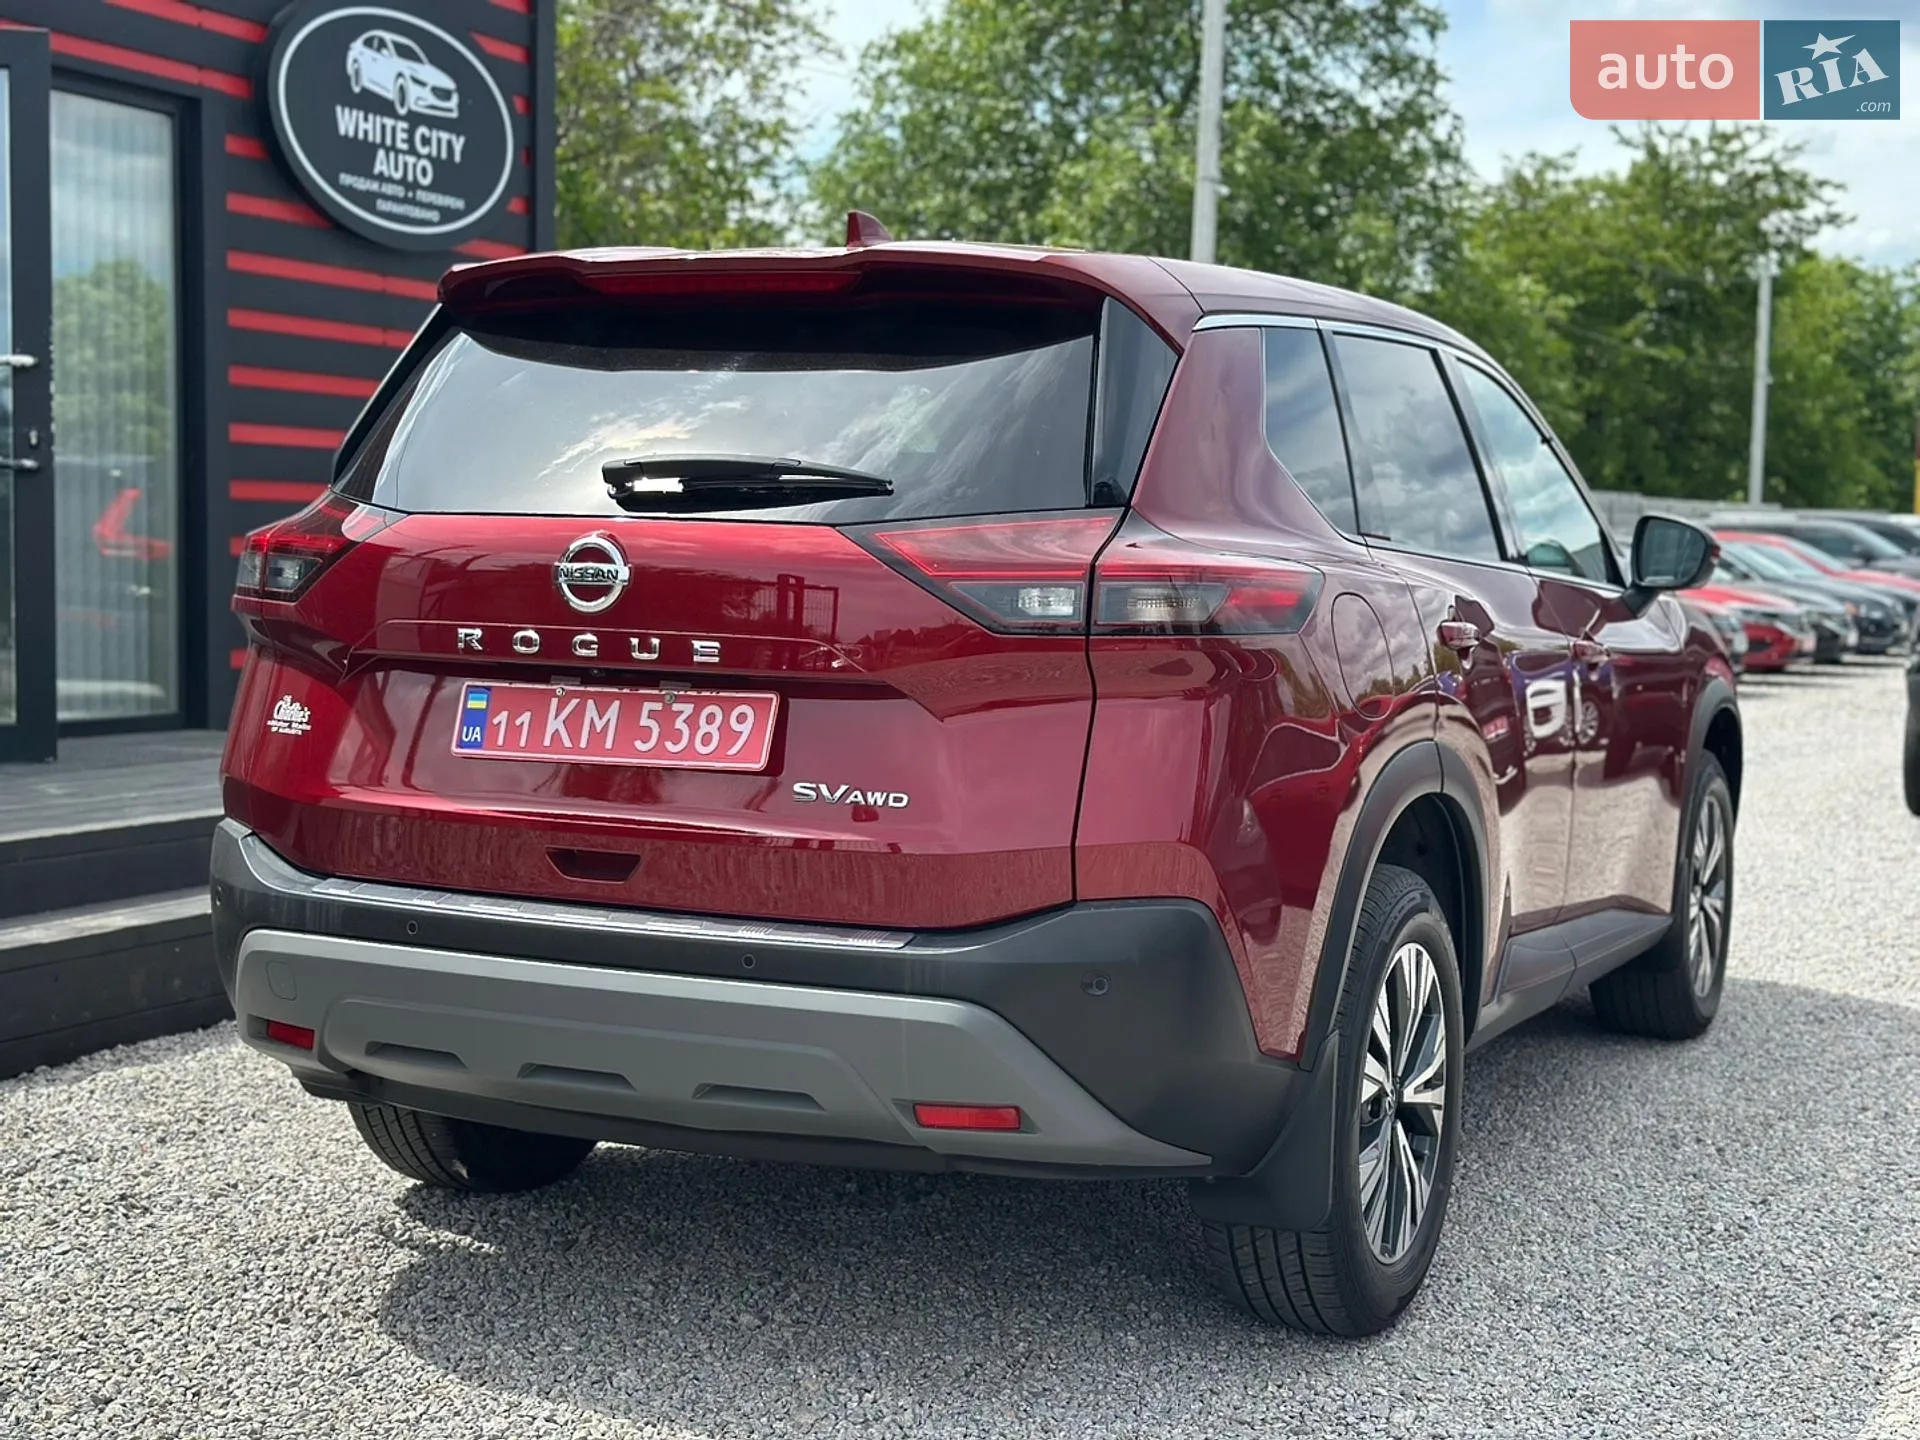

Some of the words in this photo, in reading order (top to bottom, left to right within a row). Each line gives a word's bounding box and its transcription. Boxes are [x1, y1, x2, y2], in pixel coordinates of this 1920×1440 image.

[335, 105, 409, 151] WHITE
[414, 125, 465, 164] CITY
[373, 149, 433, 186] AUTO
[560, 566, 619, 584] NISSAN
[457, 627, 720, 663] ROGUE
[462, 725, 481, 742] UA
[492, 710, 532, 748] 11
[633, 702, 754, 755] 5389
